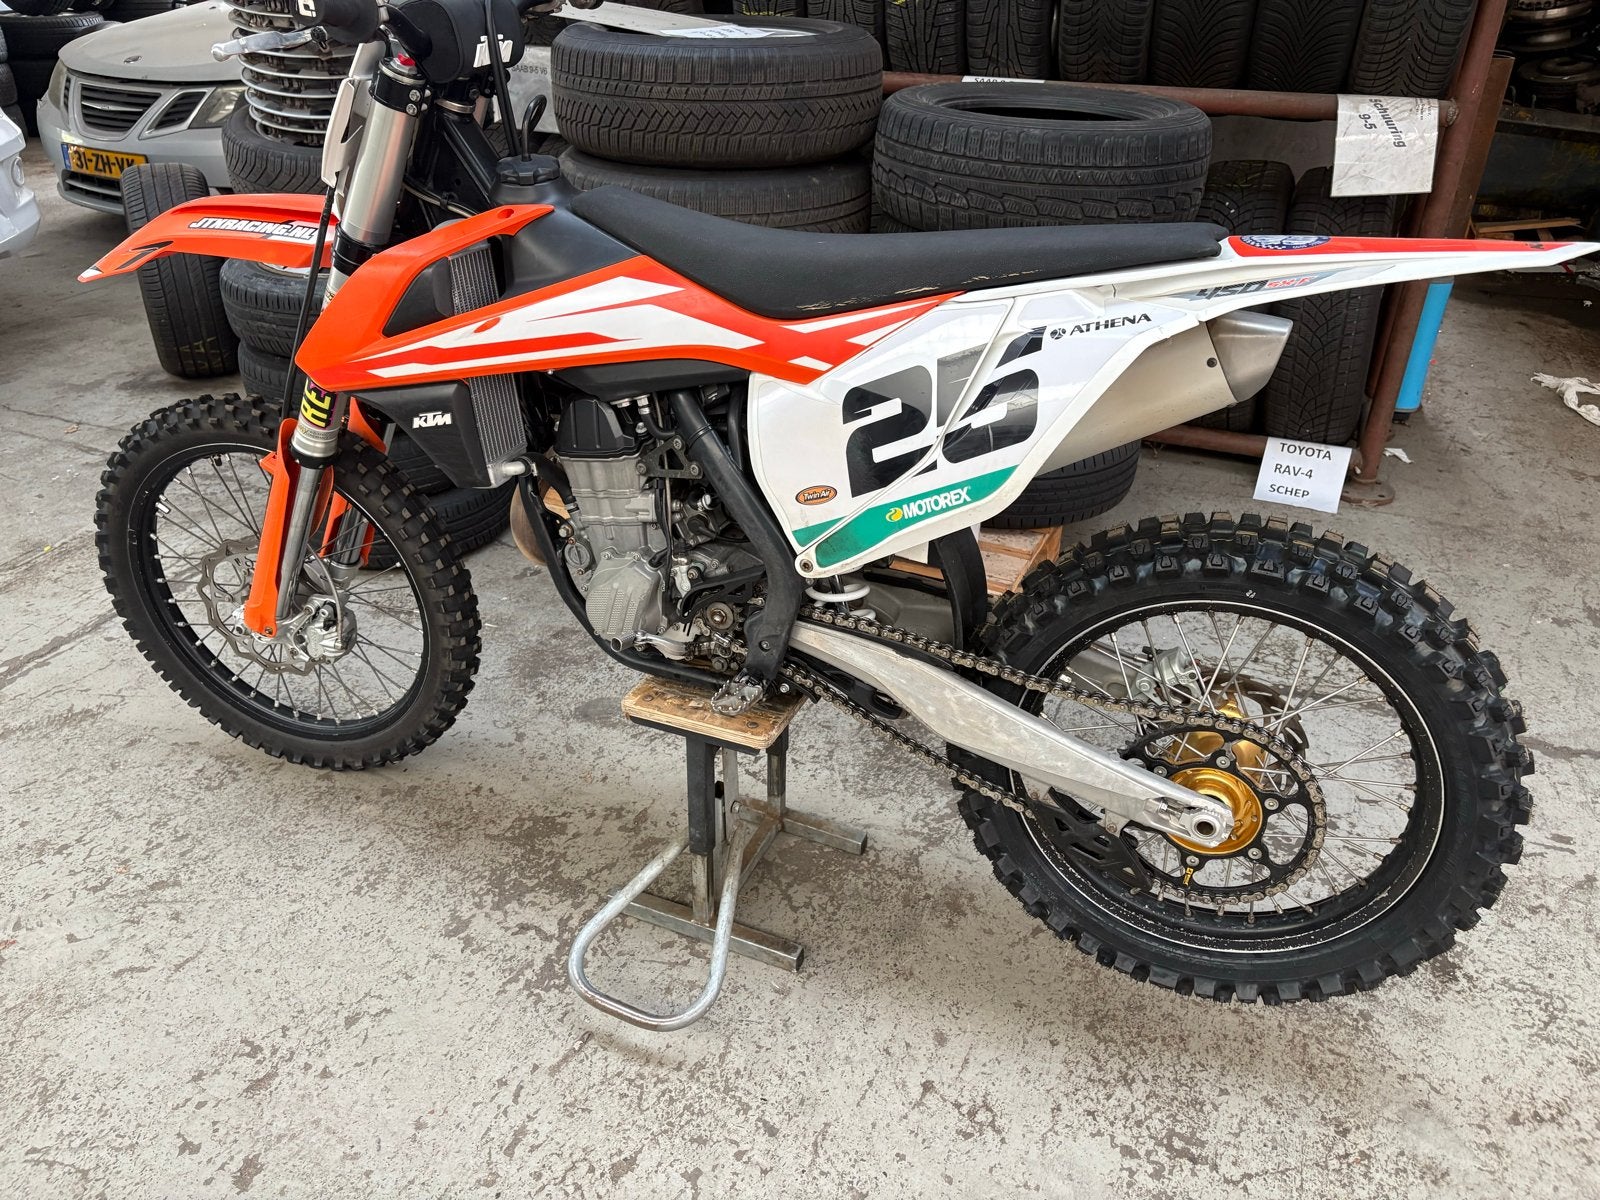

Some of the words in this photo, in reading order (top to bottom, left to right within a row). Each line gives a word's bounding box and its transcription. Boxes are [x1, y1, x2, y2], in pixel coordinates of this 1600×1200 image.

[1359, 113, 1378, 131] 9-5
[1196, 279, 1269, 300] 450
[1070, 313, 1152, 336] ATHENA
[412, 411, 452, 429] KTM
[1280, 442, 1332, 461] TOYOTA
[1274, 463, 1313, 480] RAV-4
[803, 492, 820, 502] Twin
[819, 489, 831, 499] Air
[1268, 483, 1310, 498] SCHEP
[903, 488, 972, 520] MOTOREX
